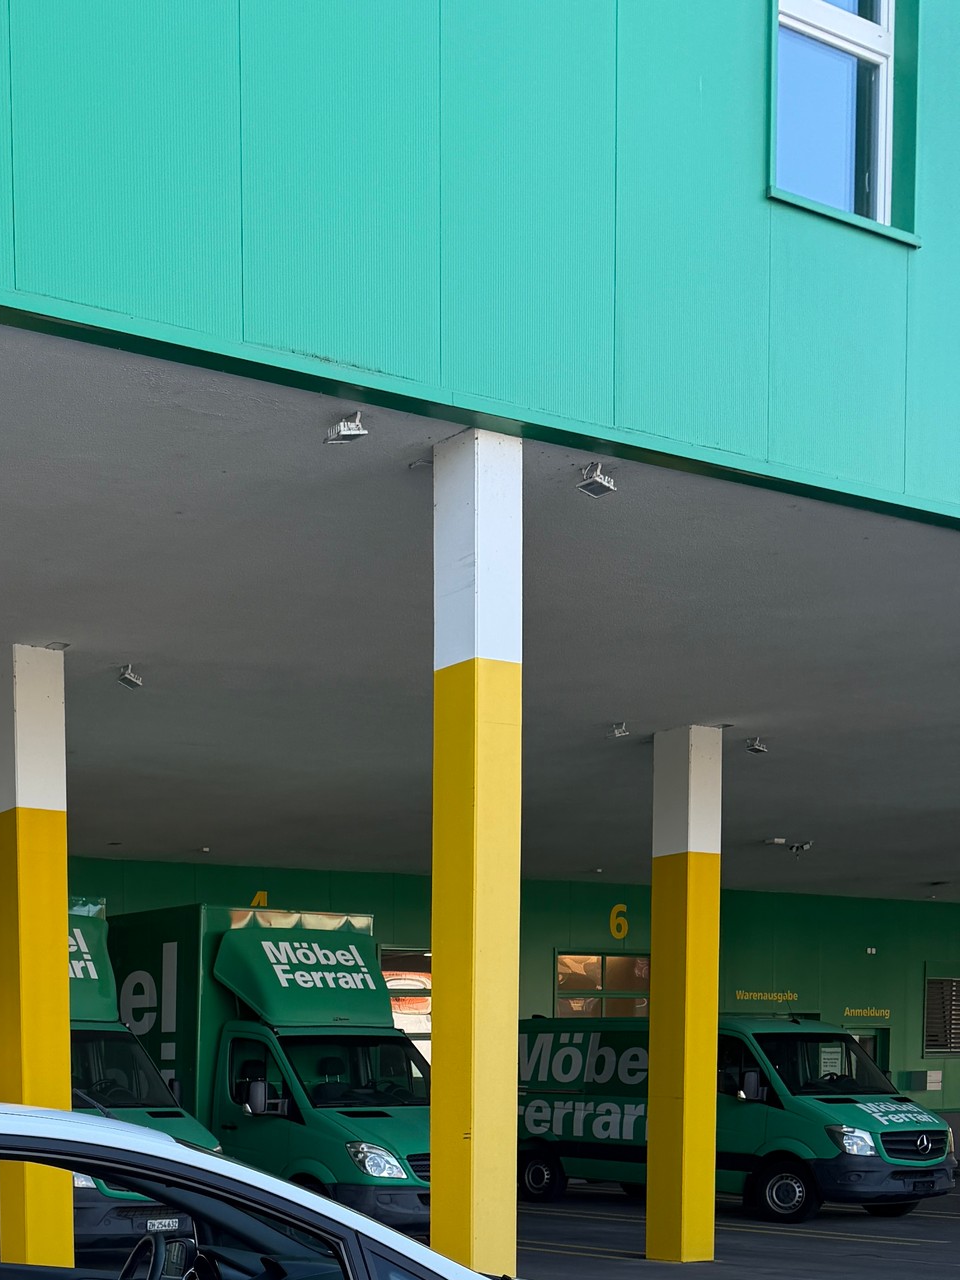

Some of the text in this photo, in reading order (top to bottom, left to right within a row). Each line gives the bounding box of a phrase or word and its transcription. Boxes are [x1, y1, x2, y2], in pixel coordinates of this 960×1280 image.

[608, 903, 629, 940] 6
[261, 941, 366, 967] Möbel
[272, 964, 377, 990] Ferrari
[735, 990, 798, 1003] Warenausgabe
[844, 1006, 891, 1019] Anmeldung
[518, 1032, 648, 1085] Möbe
[518, 1086, 648, 1141] errar
[855, 1102, 928, 1115] Möbel
[871, 1112, 940, 1126] Ferrari
